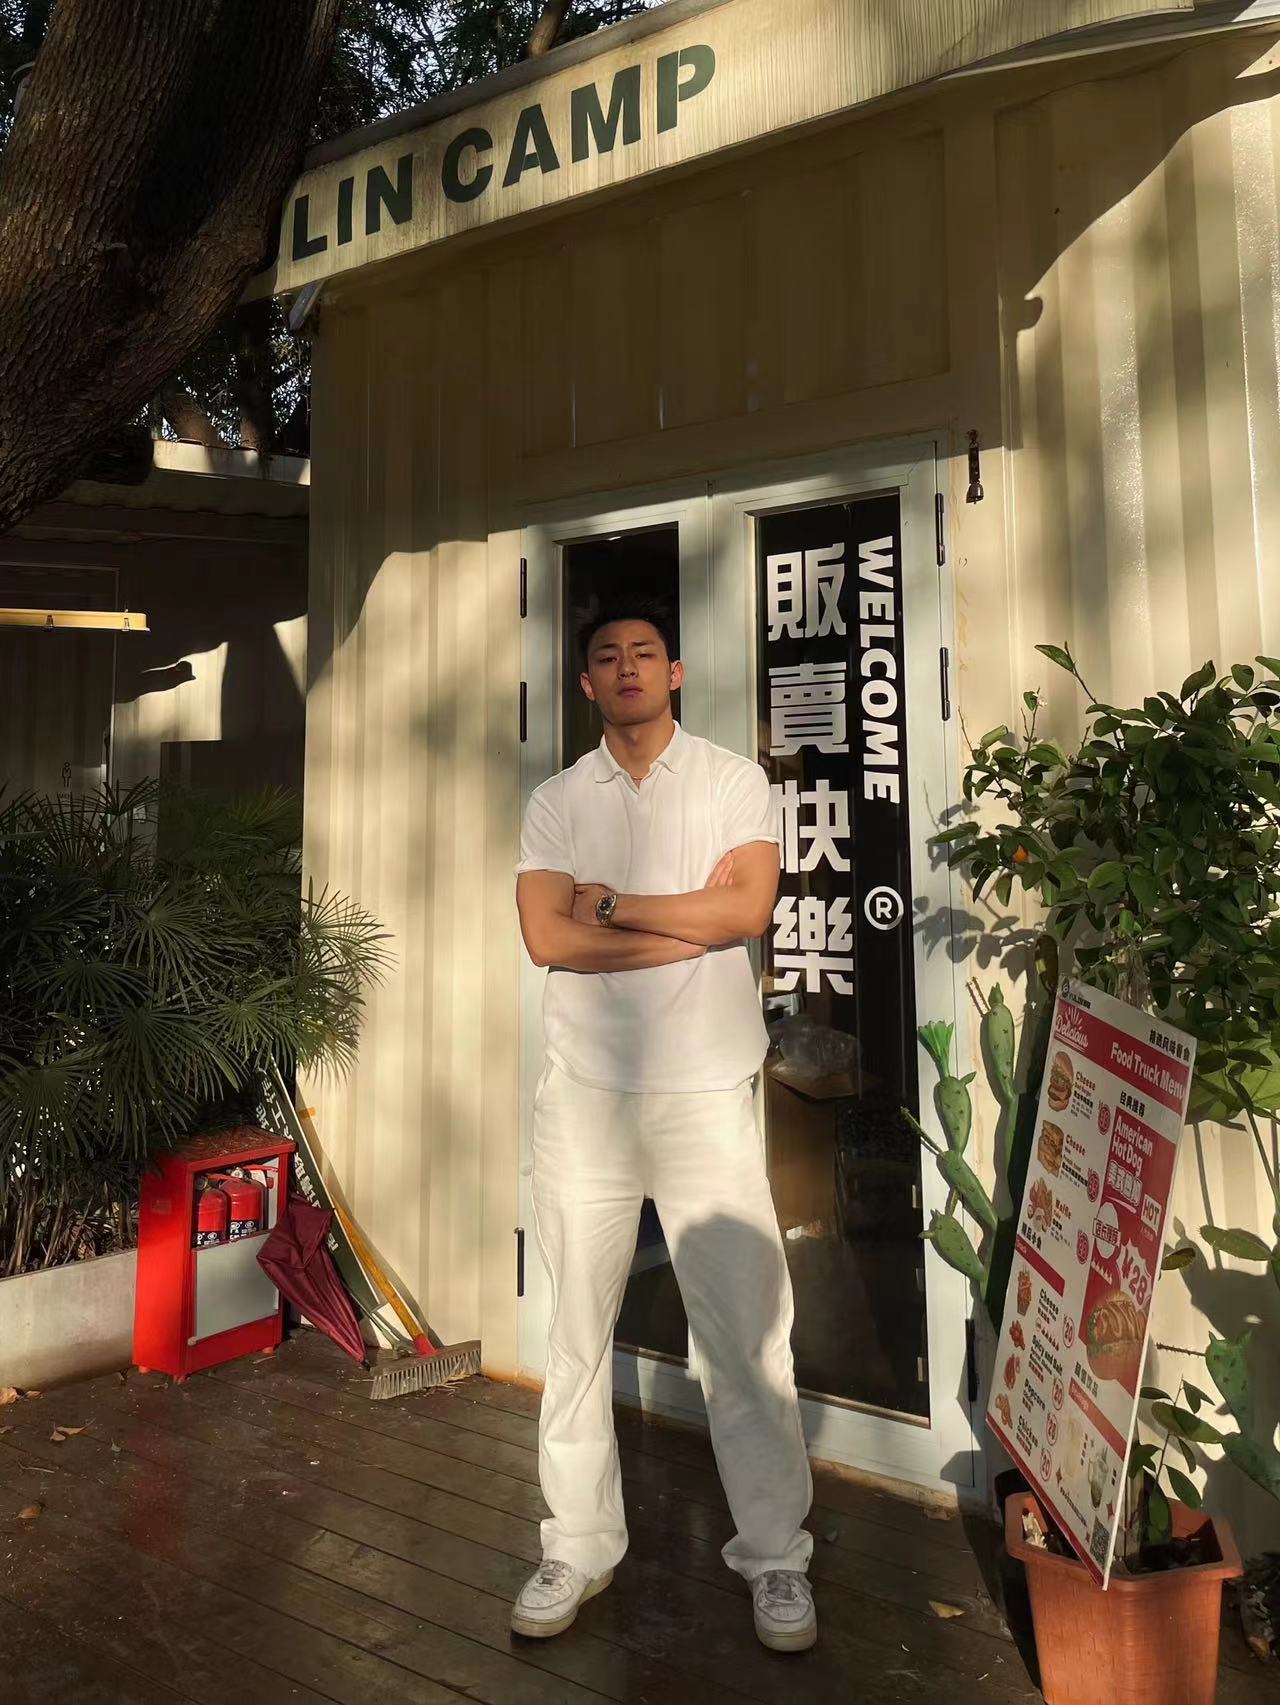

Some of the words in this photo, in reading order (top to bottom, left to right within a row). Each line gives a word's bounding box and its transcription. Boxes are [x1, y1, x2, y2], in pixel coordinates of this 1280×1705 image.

[292, 153, 413, 262] LIN
[441, 44, 716, 203] CAMP
[857, 535, 900, 804] WELCOME
[766, 542, 854, 995] 販賣快樂
[1055, 1014, 1088, 1048] Delicious
[1075, 1070, 1096, 1091] Cheese
[1111, 1042, 1134, 1070] Food
[1133, 1054, 1160, 1085] Truck
[1160, 1069, 1187, 1100] Menu
[1114, 1113, 1154, 1157] American
[1111, 1134, 1126, 1159] Hot
[1123, 1143, 1143, 1178] Dog
[1142, 1199, 1159, 1226] HOT
[1039, 1287, 1059, 1315] Cheese
[1031, 1333, 1044, 1357] Spicy
[1044, 1347, 1053, 1364] and
[1024, 1378, 1045, 1412] Popcorn
[1018, 1412, 1038, 1448] Chicken
